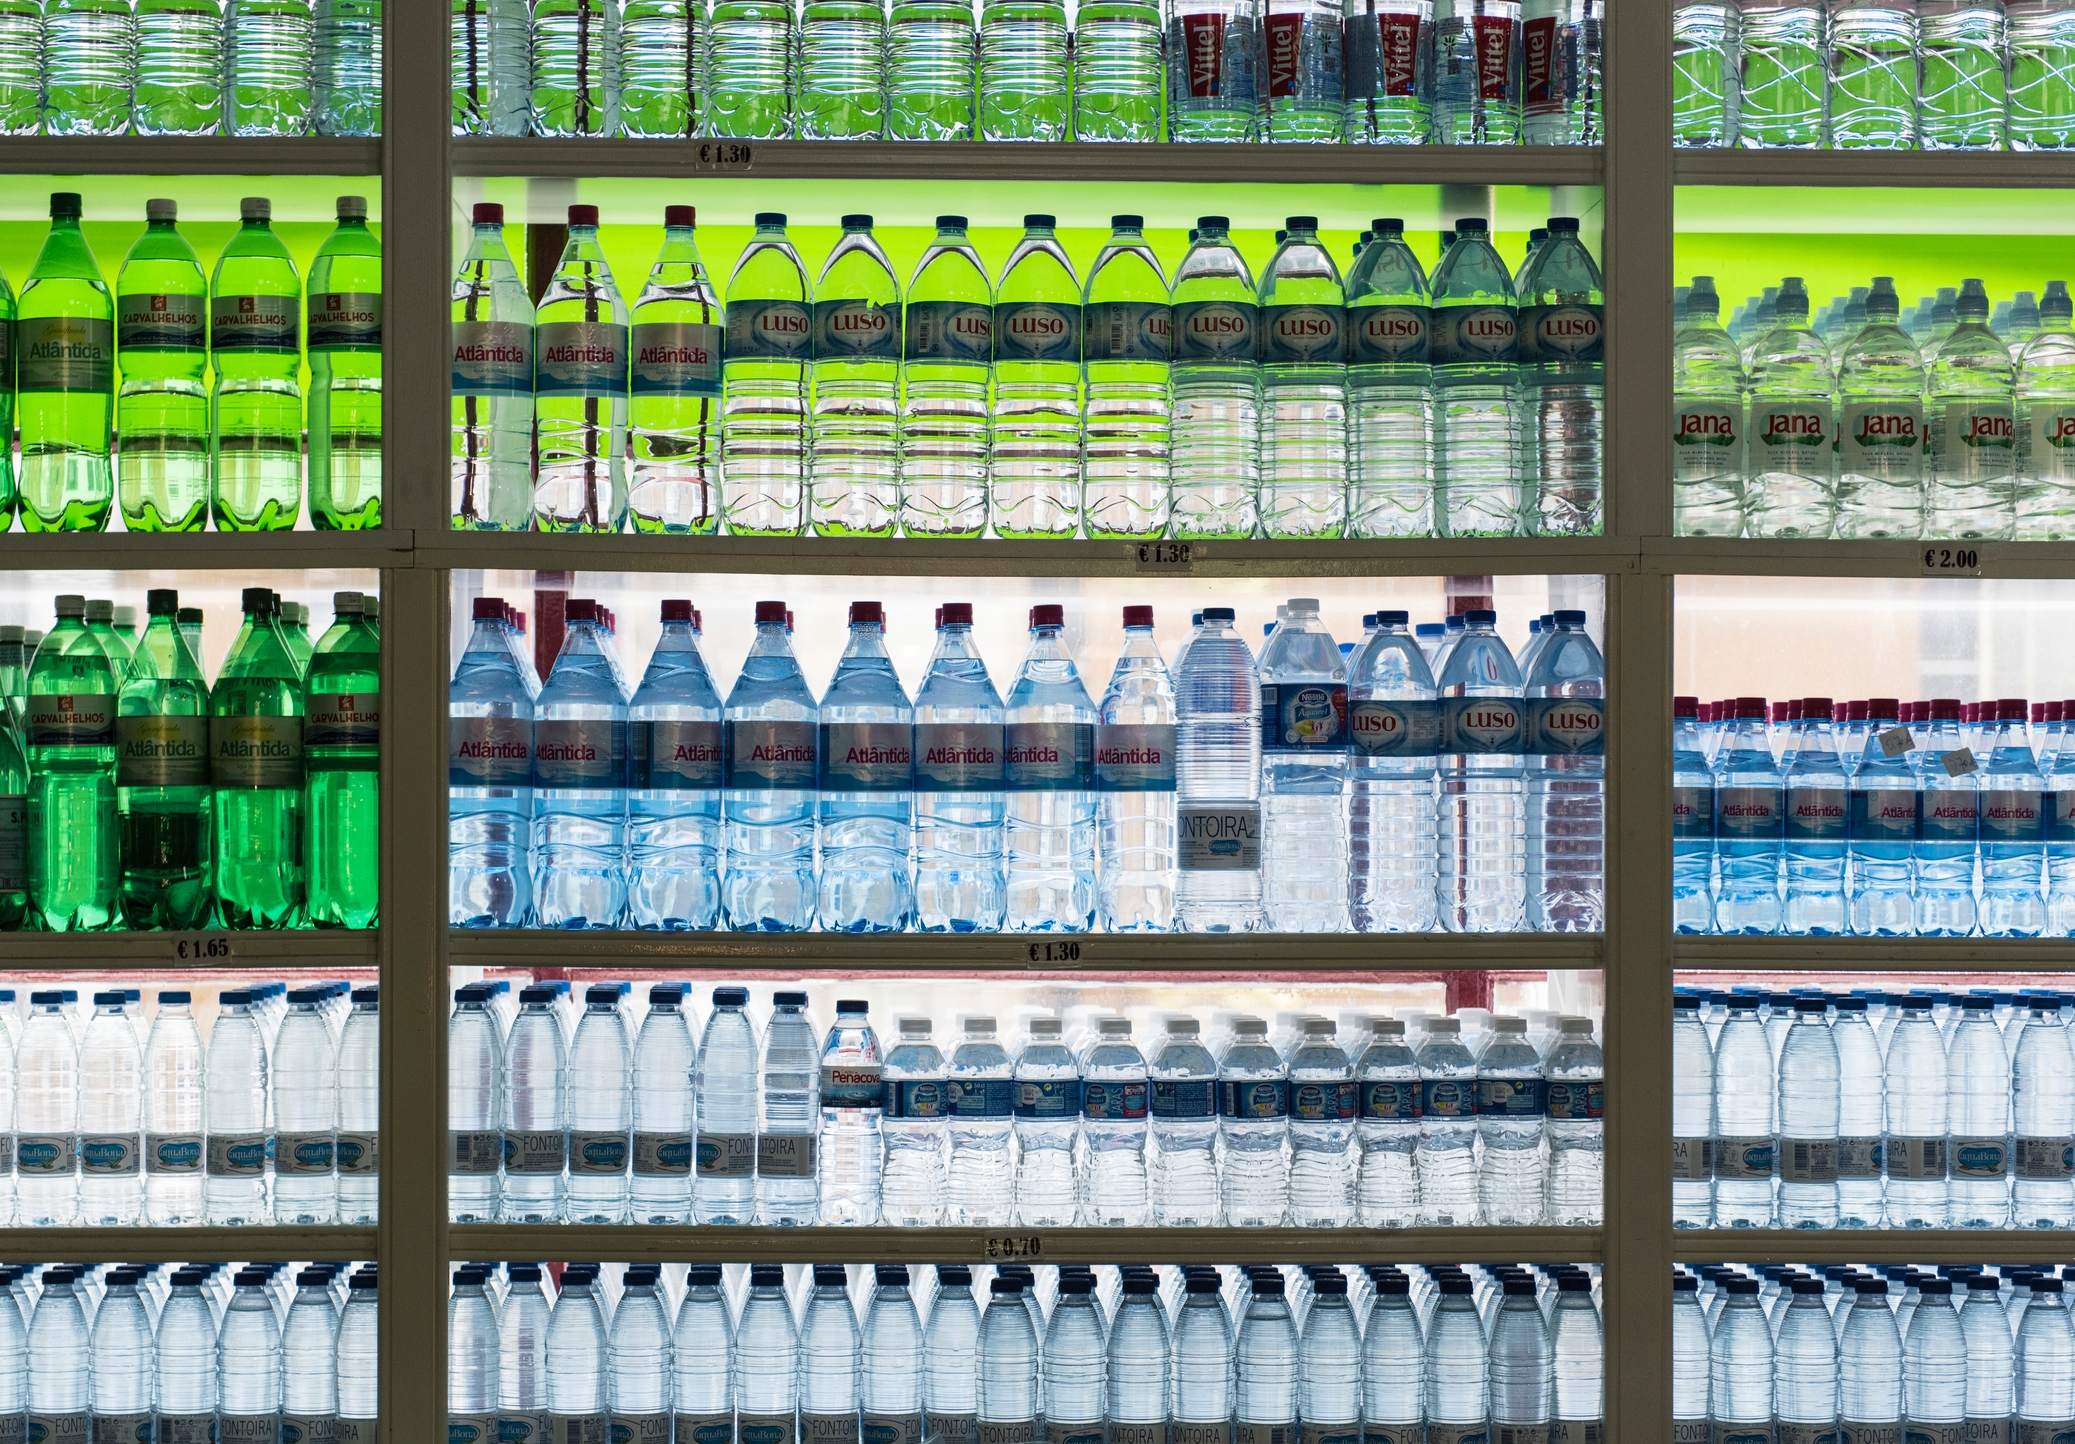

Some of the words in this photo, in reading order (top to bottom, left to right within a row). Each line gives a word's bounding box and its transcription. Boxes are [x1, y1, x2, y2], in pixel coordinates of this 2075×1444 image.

[1193, 24, 1215, 86] Vittel
[1272, 24, 1292, 86] Vittel
[1390, 25, 1411, 86] Vittel
[1483, 28, 1504, 88] Vittel
[1528, 30, 1545, 91] Vittel
[700, 144, 710, 163] €
[715, 144, 750, 163] 1.30
[123, 313, 197, 325] CARVALHELHOS
[214, 314, 287, 327] CARVALHELHOS
[762, 315, 808, 333] LUSO
[834, 314, 886, 331] LUSO
[1012, 317, 1064, 334] LUSO
[1149, 318, 1172, 337] LUS
[1193, 316, 1244, 333] LUSO
[1280, 319, 1331, 336] LUSO
[1368, 319, 1419, 336] LUSO
[1546, 319, 1597, 336] LUSO
[1467, 319, 1514, 337] LUSO
[29, 341, 101, 359] Atlântida
[454, 345, 524, 363] Atlântida
[545, 345, 614, 363] Atlântida
[639, 347, 708, 364] Atlântida
[1675, 414, 1733, 438] Jana
[1764, 414, 1822, 438] Jana
[1859, 415, 1915, 440] Jana
[1967, 416, 2013, 440] Jana
[2053, 417, 2075, 440] Ja
[1139, 544, 1149, 563] €
[1155, 544, 1190, 563] 1.30
[1925, 549, 1935, 568] €
[1940, 549, 1977, 568] 2.00
[1301, 693, 1326, 701] Nestlé
[31, 713, 105, 724] CARVALHELHOS
[311, 712, 379, 724] CARVALHELHO
[1465, 711, 1515, 728] LUSO
[1548, 713, 1600, 729] LUSO
[125, 740, 196, 757] Atlântida
[219, 740, 290, 757] Atlântida
[458, 741, 527, 759] Atlântida
[535, 743, 596, 761] Atlântida
[674, 745, 723, 761] Atlântid
[751, 745, 815, 761] Atlântida
[846, 747, 910, 764] Atlântida
[926, 747, 994, 764] Atlântida
[1007, 746, 1059, 763] tlântida
[1098, 748, 1161, 765] Atlântida
[1723, 804, 1769, 816] Atlântida
[1796, 805, 1843, 817] Atlântida
[1881, 807, 1915, 818] Atlânti
[1933, 806, 1977, 818] Atlântida
[1987, 807, 2035, 819] Atlântida
[1179, 815, 1250, 839] ONTOIRA
[178, 940, 188, 959] €
[193, 938, 228, 958] 1.65
[1029, 943, 1039, 961] €
[1045, 942, 1080, 961] 1.30
[832, 1070, 880, 1084] Penacova
[524, 1135, 564, 1152] FONTOI
[758, 1137, 795, 1155] NTOIRA
[229, 1148, 264, 1160] aquaBon
[296, 1147, 332, 1159] aquaBon
[989, 1238, 998, 1257] €
[1003, 1237, 1040, 1256] 0.70
[55, 1416, 87, 1434] FONTO
[222, 1419, 272, 1436] FONTOIRA
[813, 1419, 859, 1436] FONTOIR
[932, 1418, 976, 1436] FONTOIR
[696, 1429, 731, 1441] aquaBon
[1109, 1428, 1154, 1444] ONTOIRA
[1857, 1428, 1900, 1444] FONTOIR
